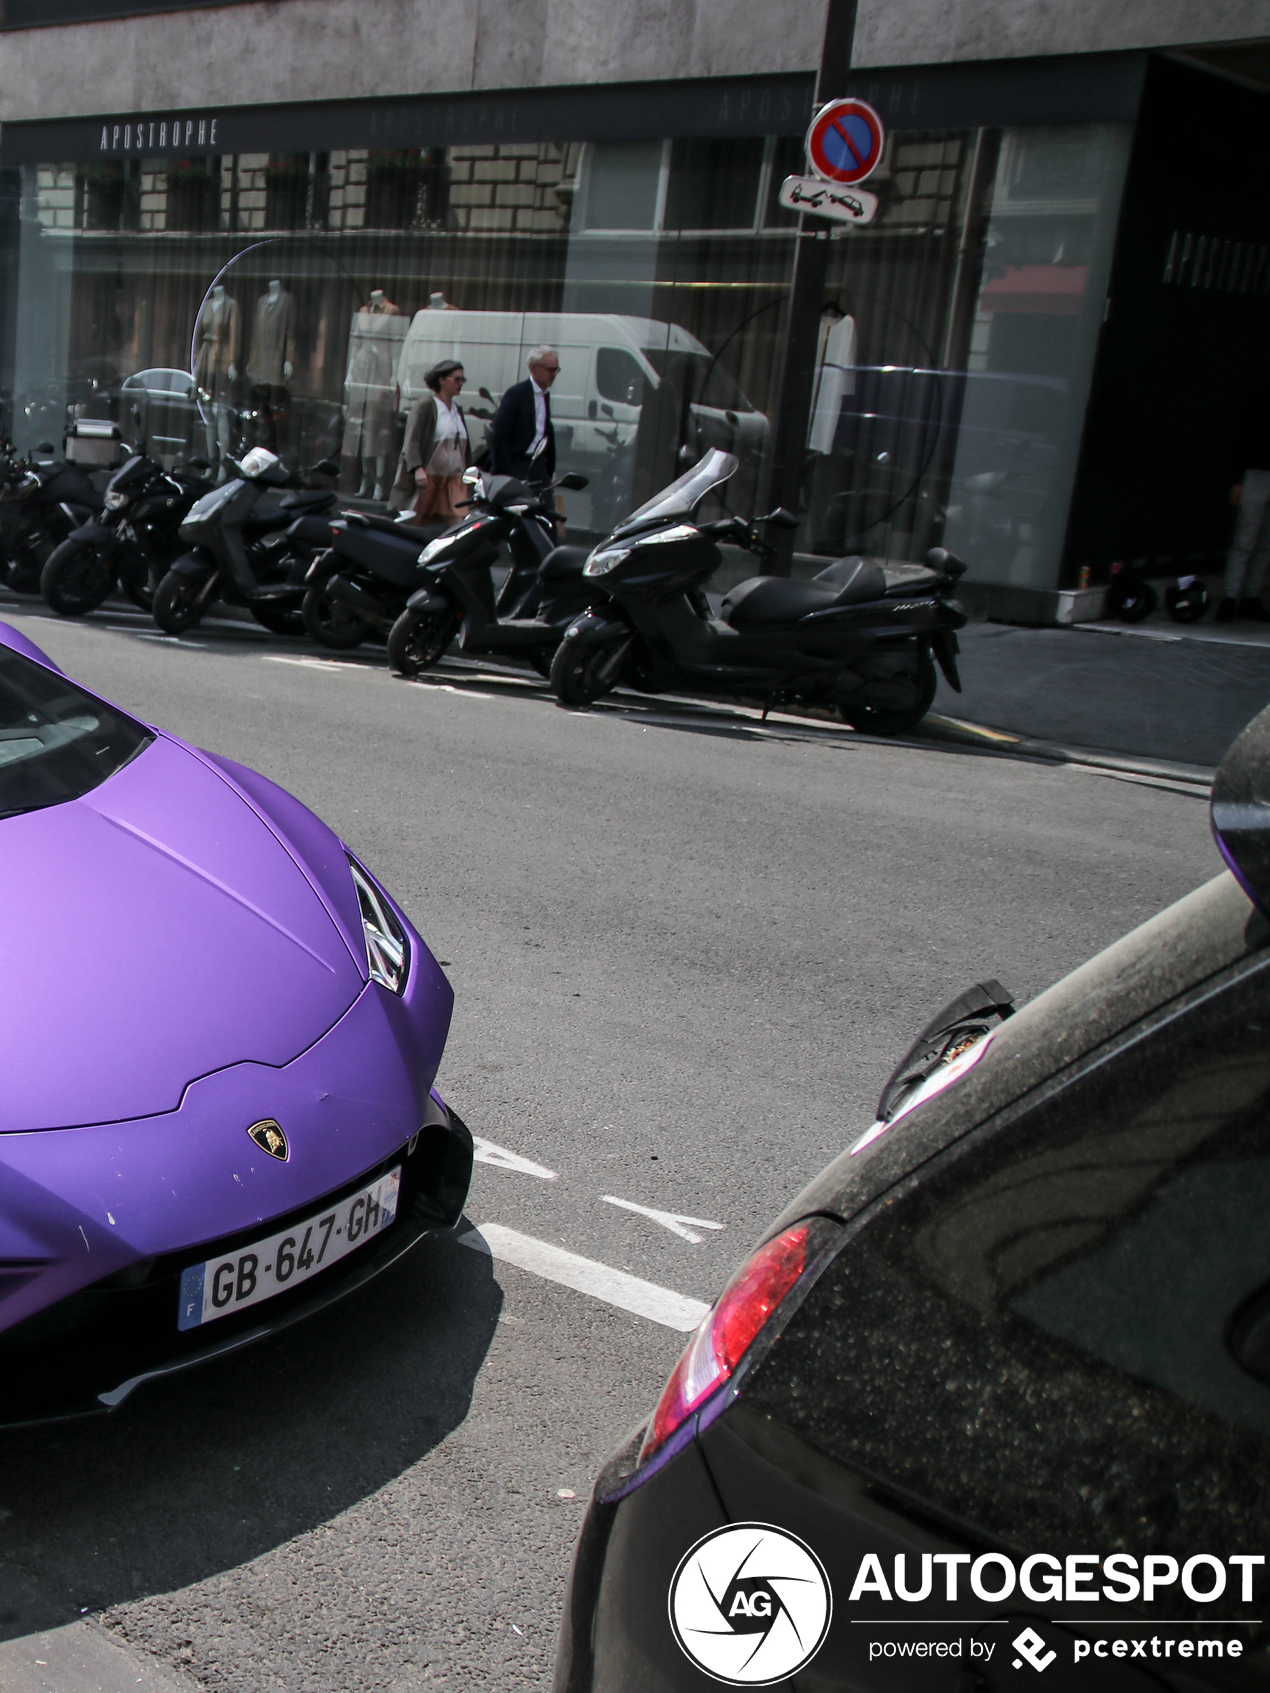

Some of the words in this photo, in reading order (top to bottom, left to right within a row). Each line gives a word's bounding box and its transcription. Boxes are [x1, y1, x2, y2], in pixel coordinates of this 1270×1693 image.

[718, 81, 922, 122] APOSTPHE
[99, 119, 218, 150] APOSTROPHE
[1163, 228, 1270, 295] APOSTROP
[210, 1185, 383, 1309] GB-647-GH
[186, 1303, 195, 1318] F
